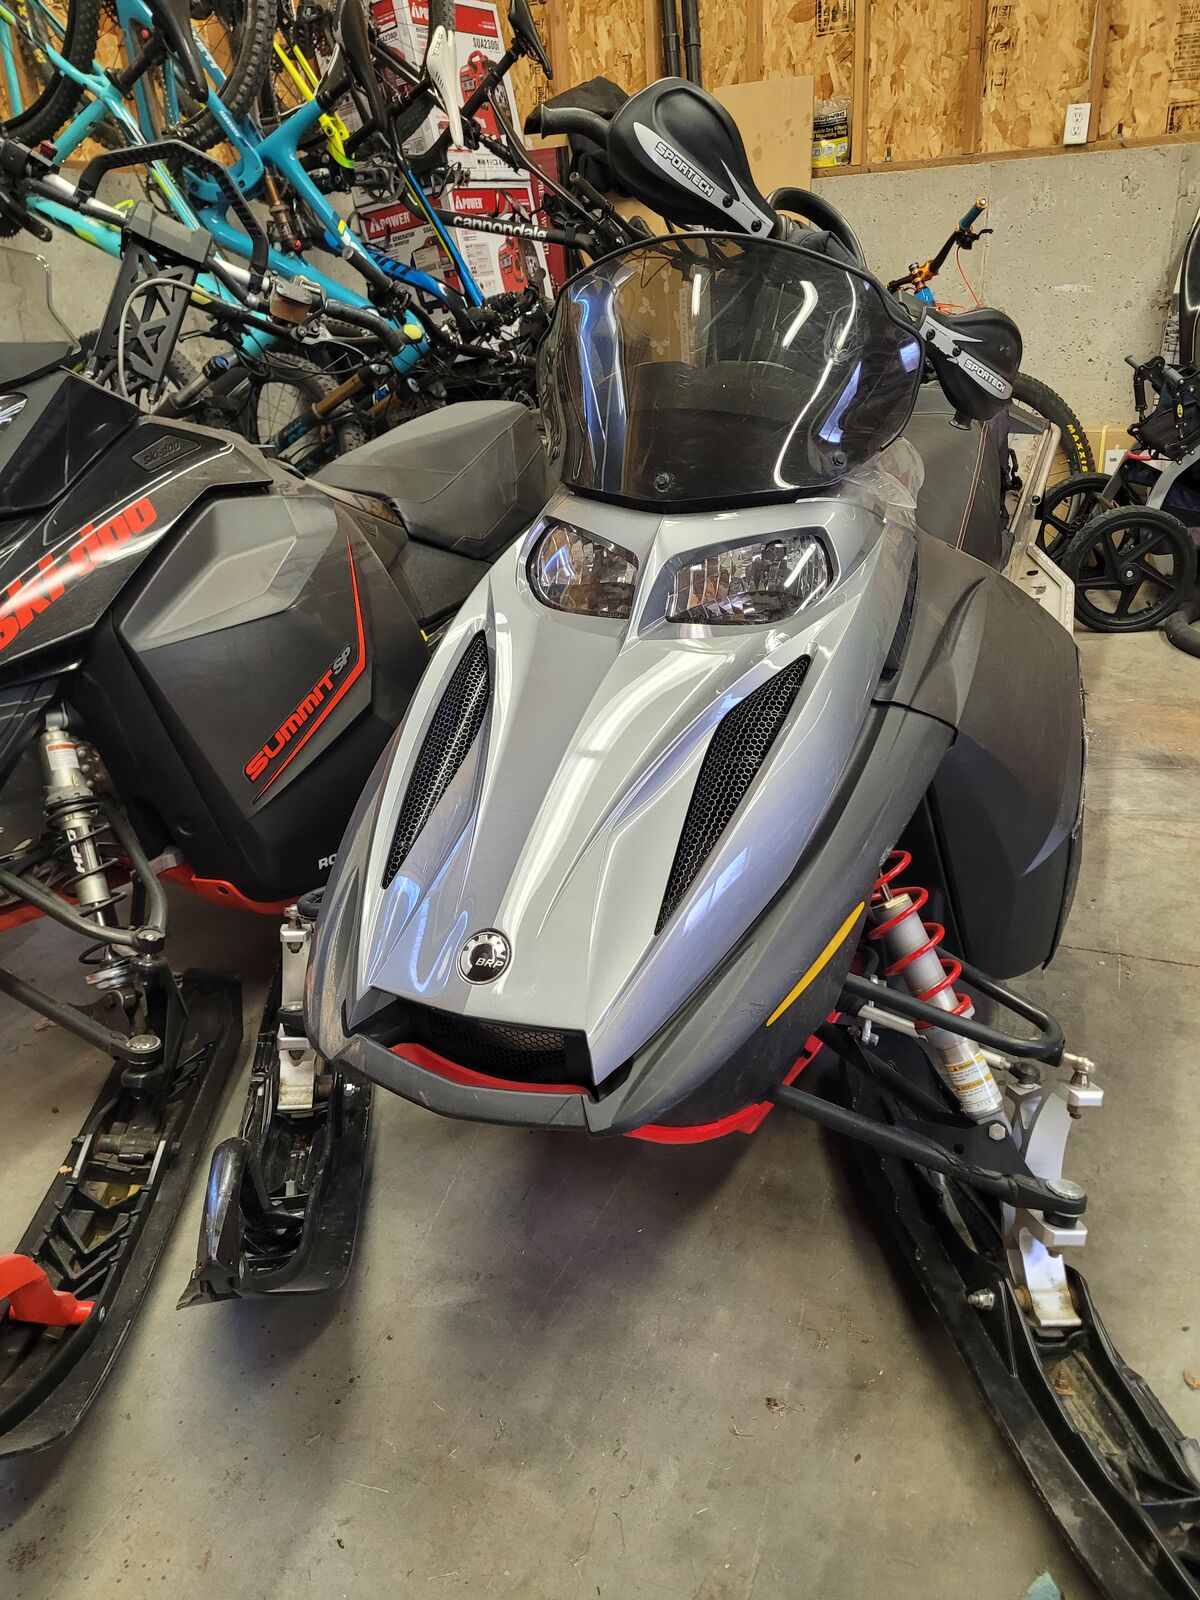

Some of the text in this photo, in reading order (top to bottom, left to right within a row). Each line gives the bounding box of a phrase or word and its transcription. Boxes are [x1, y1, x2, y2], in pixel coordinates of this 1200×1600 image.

[654, 141, 714, 198] SPORTECH
[453, 215, 548, 240] cannondale
[964, 358, 1007, 394] SPORTECH
[1066, 424, 1089, 472] MAXXIS
[244, 645, 352, 782] SUMMIT SP
[475, 957, 504, 969] BRP
